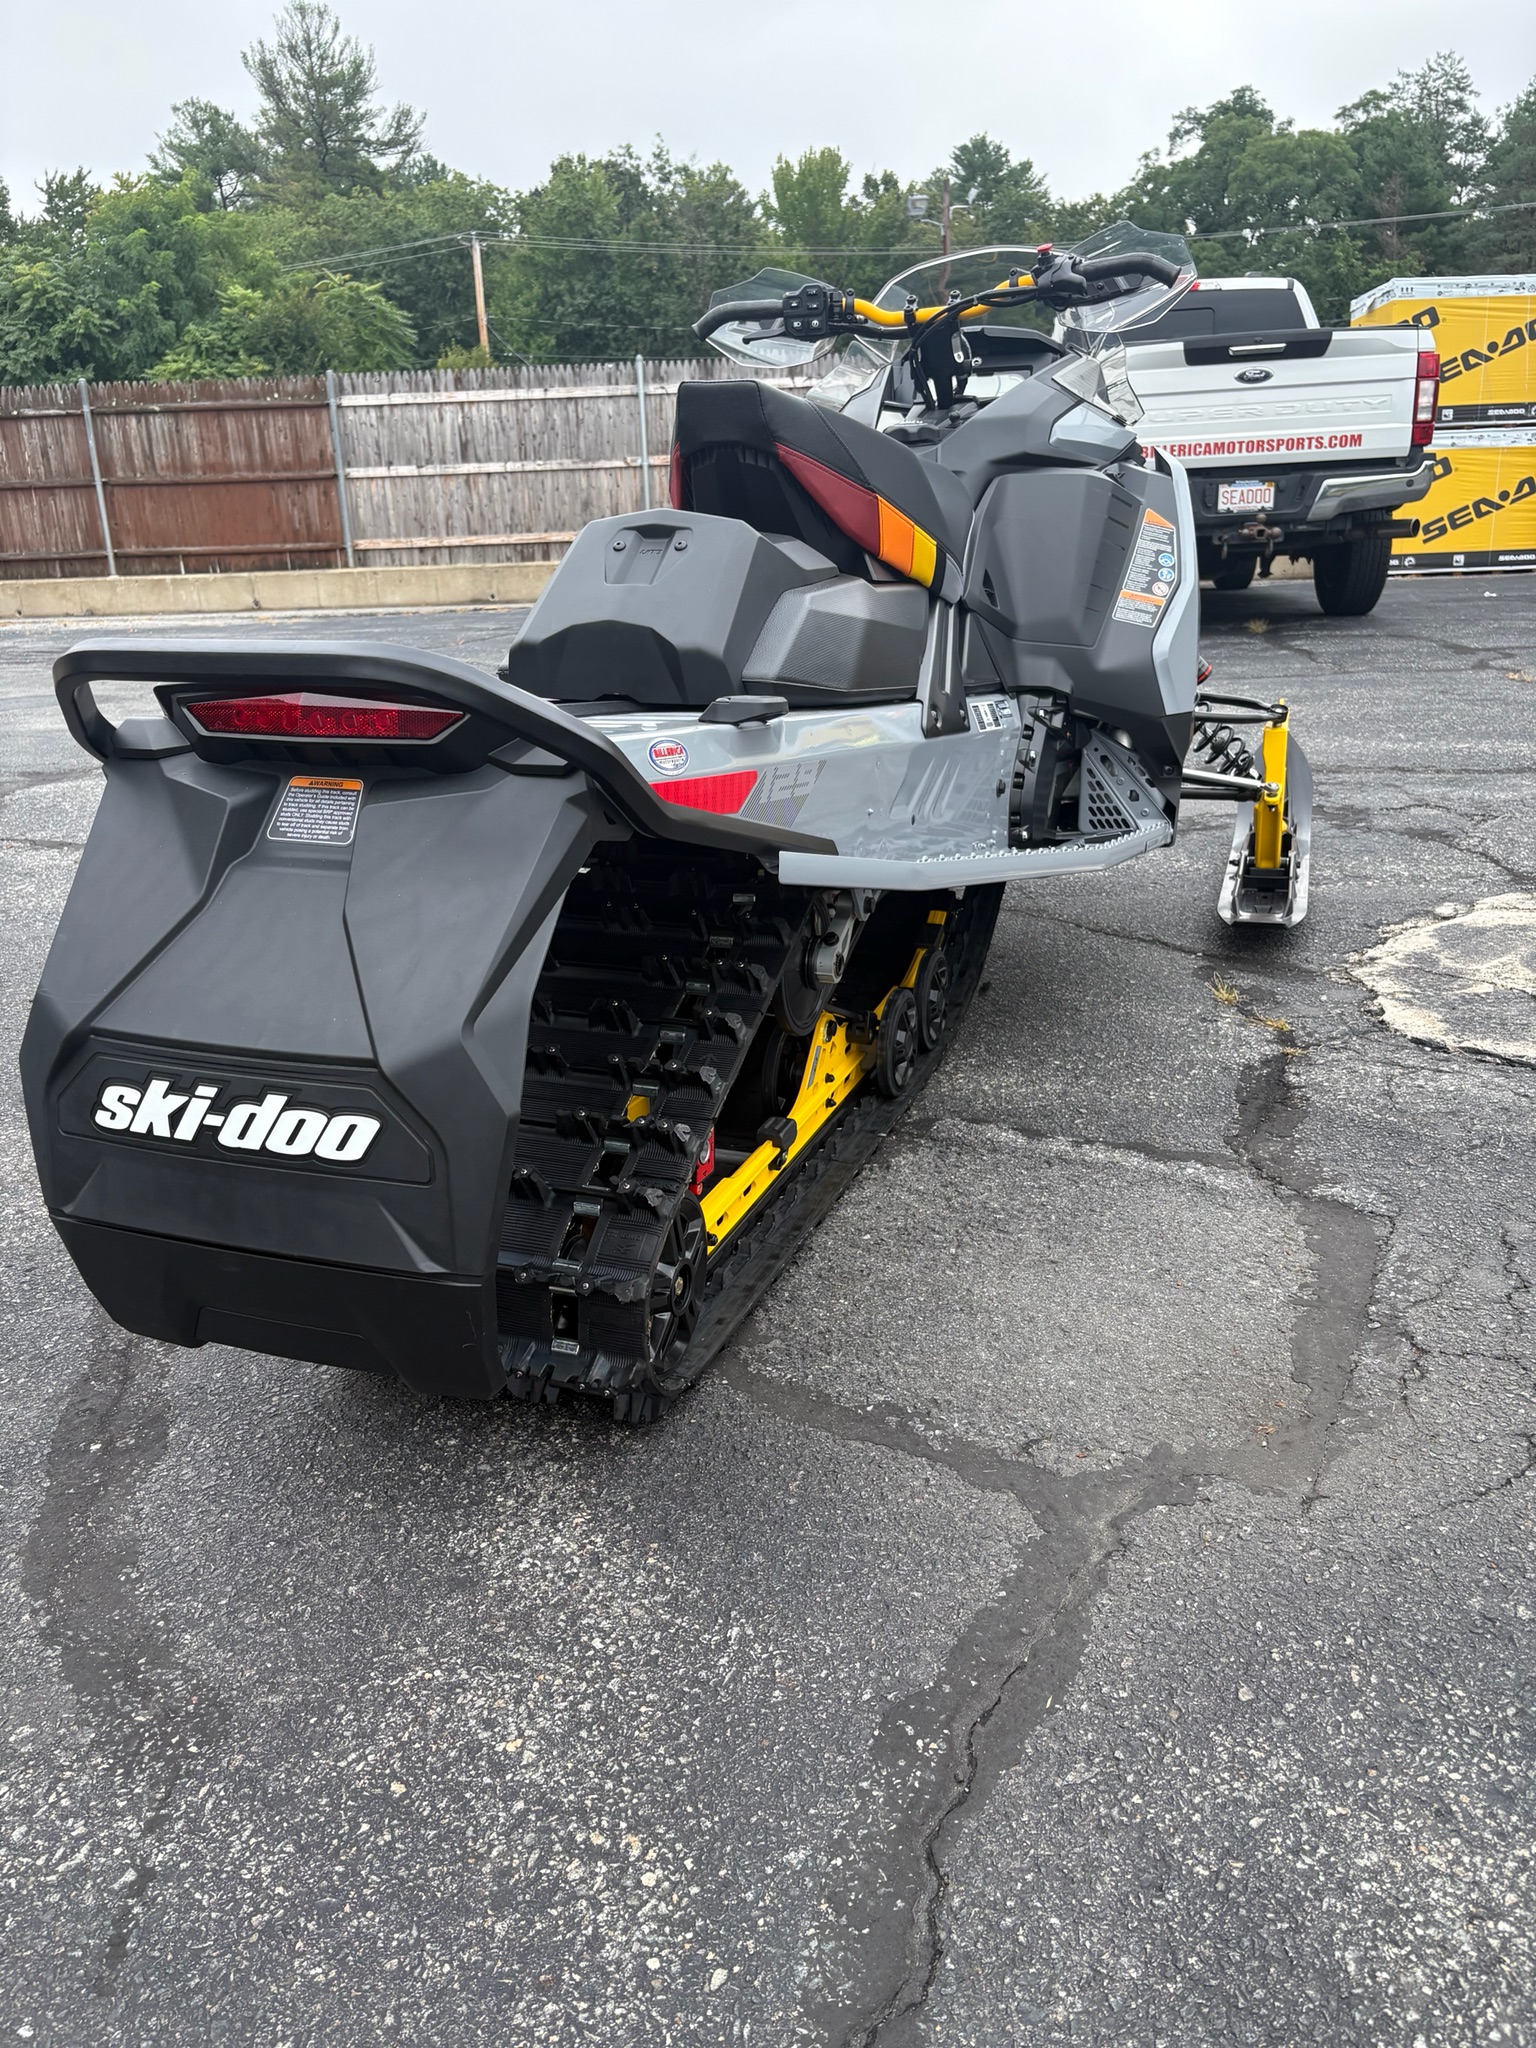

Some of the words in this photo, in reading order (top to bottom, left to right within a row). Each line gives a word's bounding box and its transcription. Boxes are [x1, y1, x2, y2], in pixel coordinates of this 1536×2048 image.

[1149, 403, 1264, 423] UPER
[1275, 397, 1390, 415] DUTY
[1141, 433, 1363, 459] BIERICAMOTORSPORTS.COM
[1221, 488, 1272, 505] SEADOO
[95, 1079, 381, 1161] ski-doo
